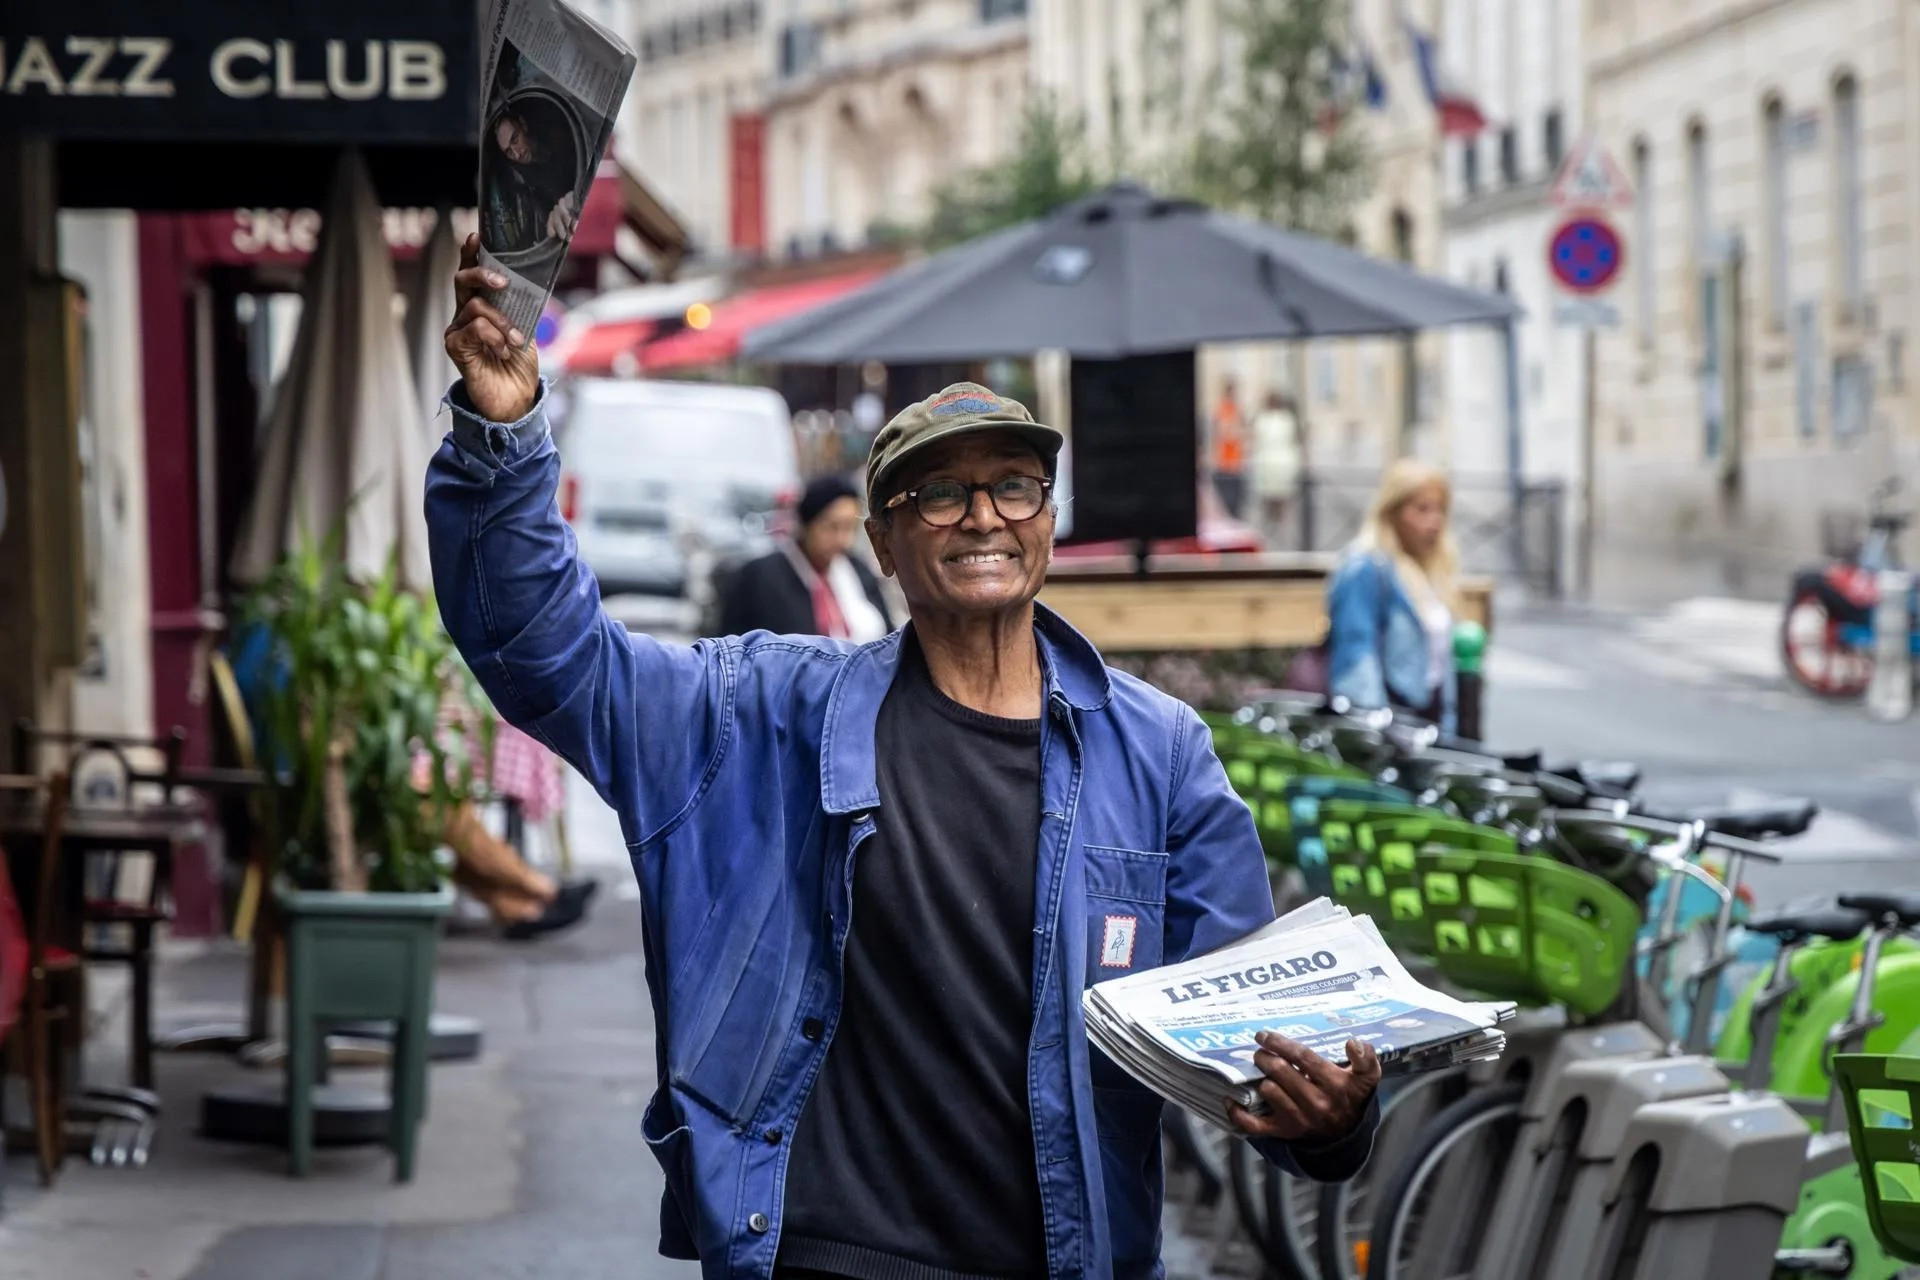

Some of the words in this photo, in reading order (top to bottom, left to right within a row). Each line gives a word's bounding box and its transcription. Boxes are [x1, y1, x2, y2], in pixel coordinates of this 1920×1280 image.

[210, 38, 448, 99] CLUB
[1161, 980, 1212, 1004] LE
[1203, 950, 1338, 993] FIGARO
